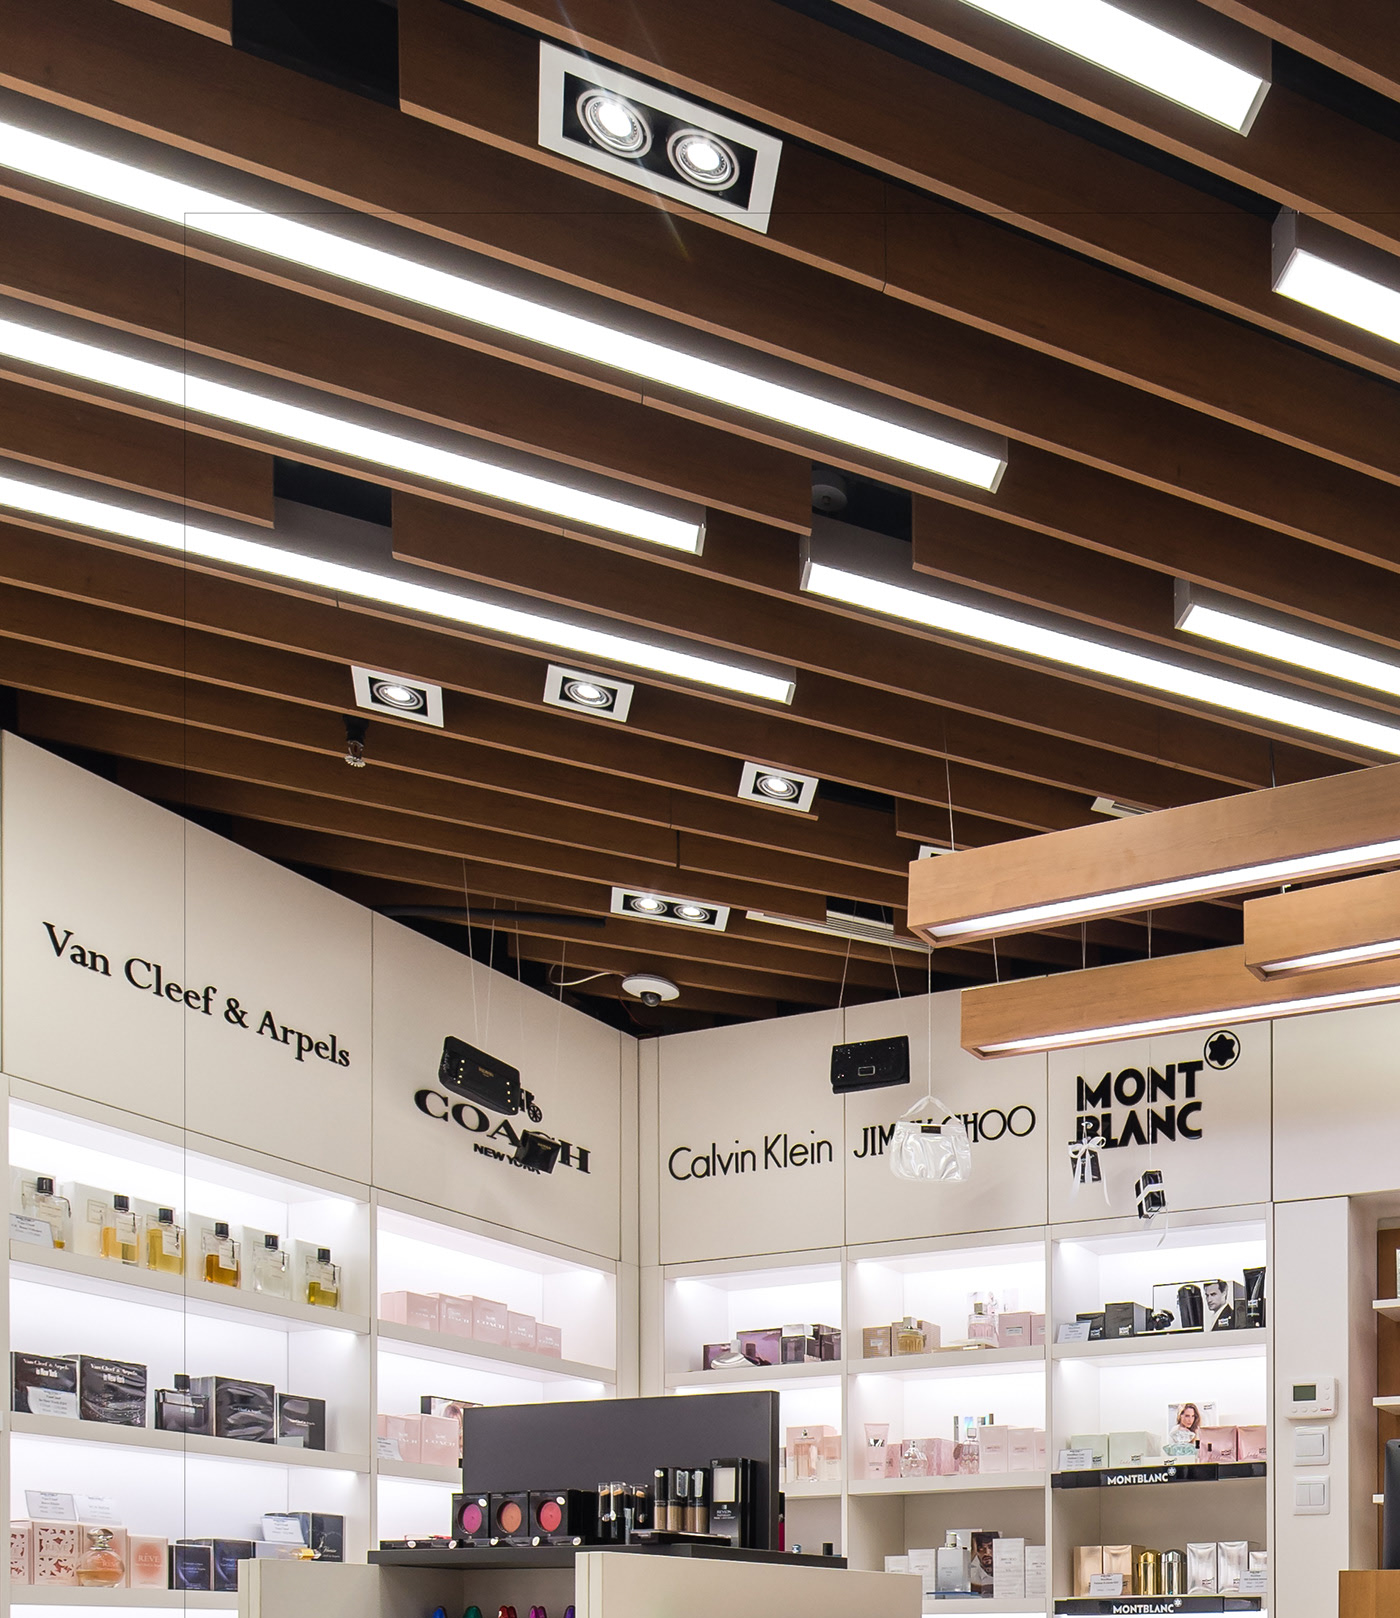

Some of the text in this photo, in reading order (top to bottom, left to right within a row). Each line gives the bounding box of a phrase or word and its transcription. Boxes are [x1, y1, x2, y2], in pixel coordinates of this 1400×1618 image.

[42, 921, 350, 1068] Van Cleef & Arpels
[1077, 1060, 1203, 1111] MONT
[414, 1089, 591, 1174] COAH
[853, 1105, 1036, 1158] JIM HOO
[1077, 1101, 1202, 1149] BLANC
[473, 1143, 505, 1162] NEW
[669, 1130, 832, 1181] Calvin Klein
[1107, 1472, 1169, 1485] MONTBLANC
[1112, 1603, 1174, 1615] MONTBLANC
